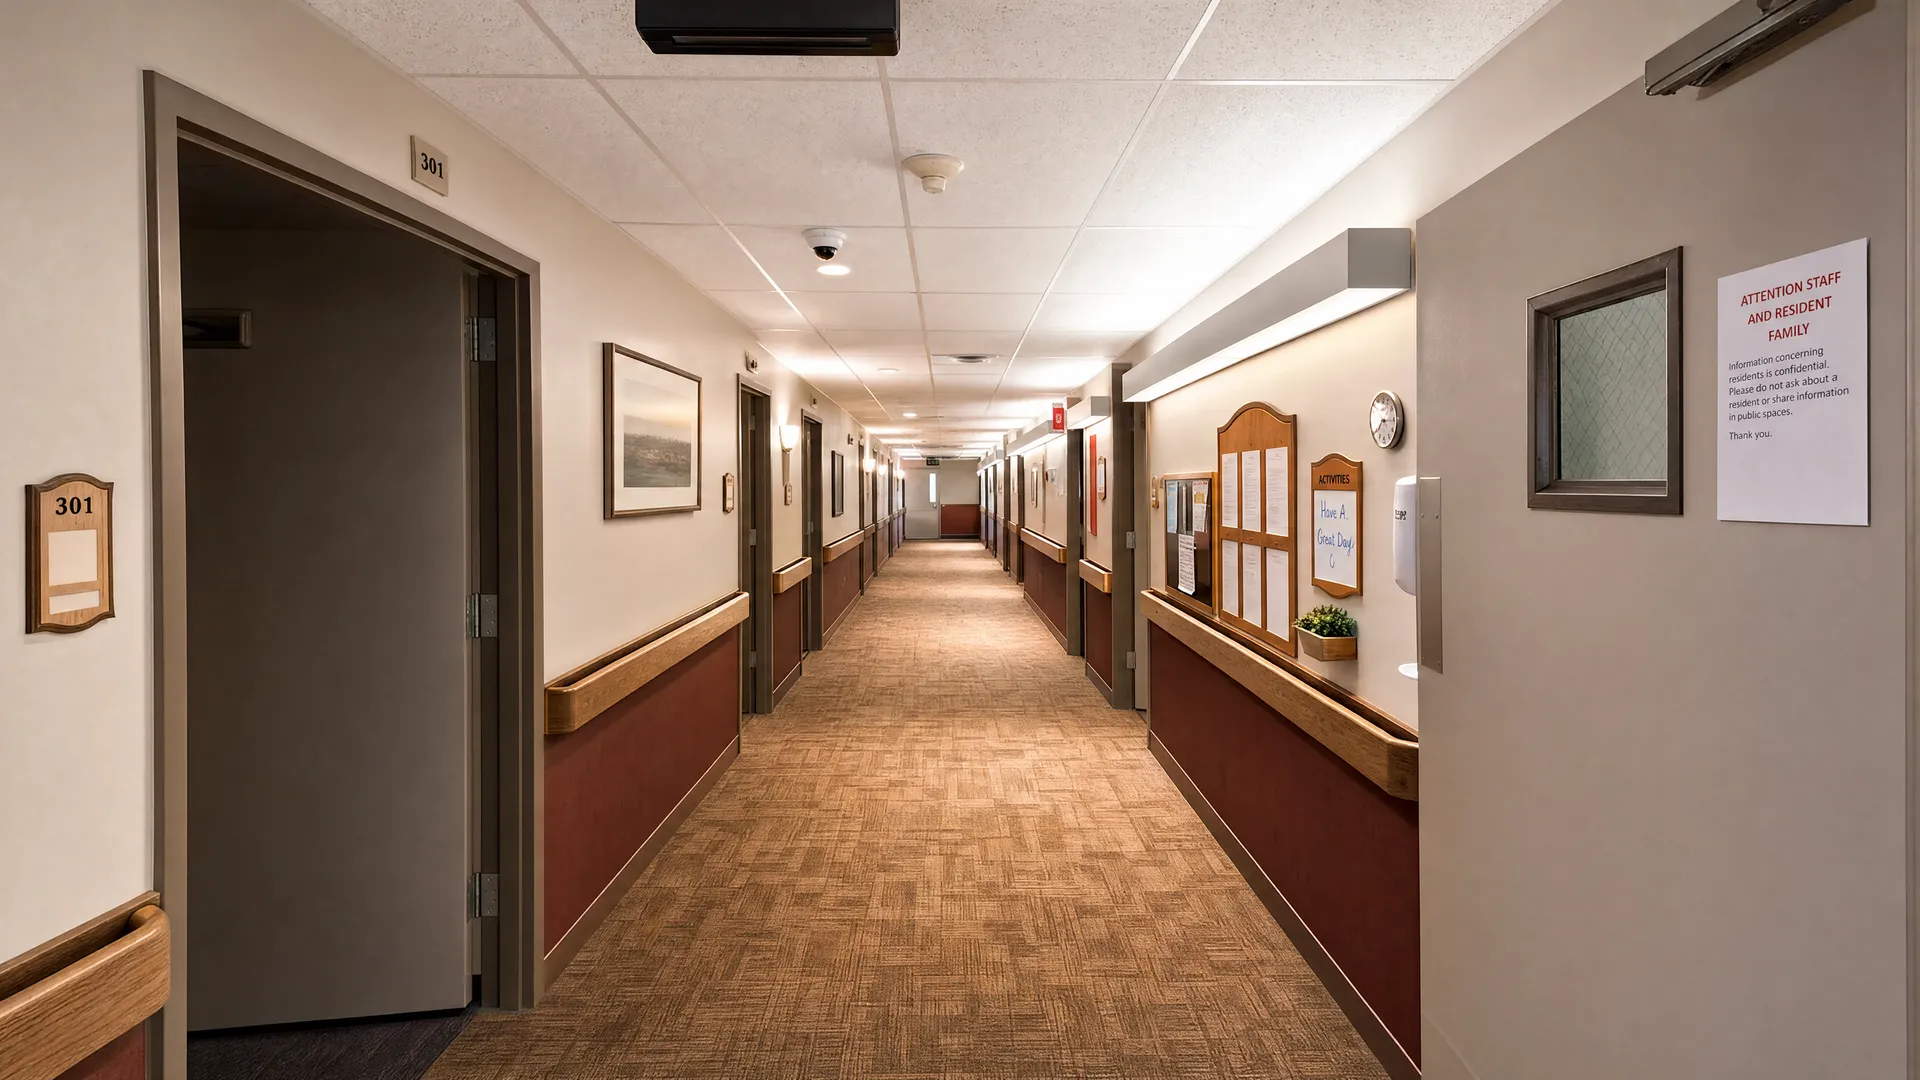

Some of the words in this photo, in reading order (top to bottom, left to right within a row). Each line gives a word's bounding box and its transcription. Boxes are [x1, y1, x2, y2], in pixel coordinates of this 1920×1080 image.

[421, 152, 444, 180] 301
[1740, 281, 1803, 307] ATTENTION
[1806, 271, 1841, 290] STAFF
[1747, 310, 1772, 325] AND
[1775, 295, 1832, 319] RESIDENT
[1768, 322, 1810, 342] FAMILY
[1728, 356, 1774, 371] Information
[1775, 347, 1824, 363] concerning
[1728, 371, 1764, 384] residents
[1766, 369, 1773, 378] is
[1774, 360, 1830, 377] confidential.
[1729, 386, 1754, 396] Please
[1755, 383, 1767, 393] do
[1769, 382, 1784, 391] not
[1785, 378, 1800, 388] ask
[1802, 375, 1829, 386] about
[1831, 374, 1838, 382] a
[1729, 398, 1760, 409] resident
[1761, 397, 1771, 405] or
[1772, 394, 1795, 404] share
[1796, 387, 1850, 401] information
[1728, 412, 1736, 421] in
[1737, 410, 1761, 422] public
[1762, 408, 1793, 420] spaces.
[1729, 430, 1753, 441] Thank
[1754, 431, 1772, 441] you.
[1318, 474, 1350, 485] ACTIVITIES
[55, 496, 93, 515] 301
[1320, 500, 1337, 519] Have
[1317, 528, 1335, 546] Great
